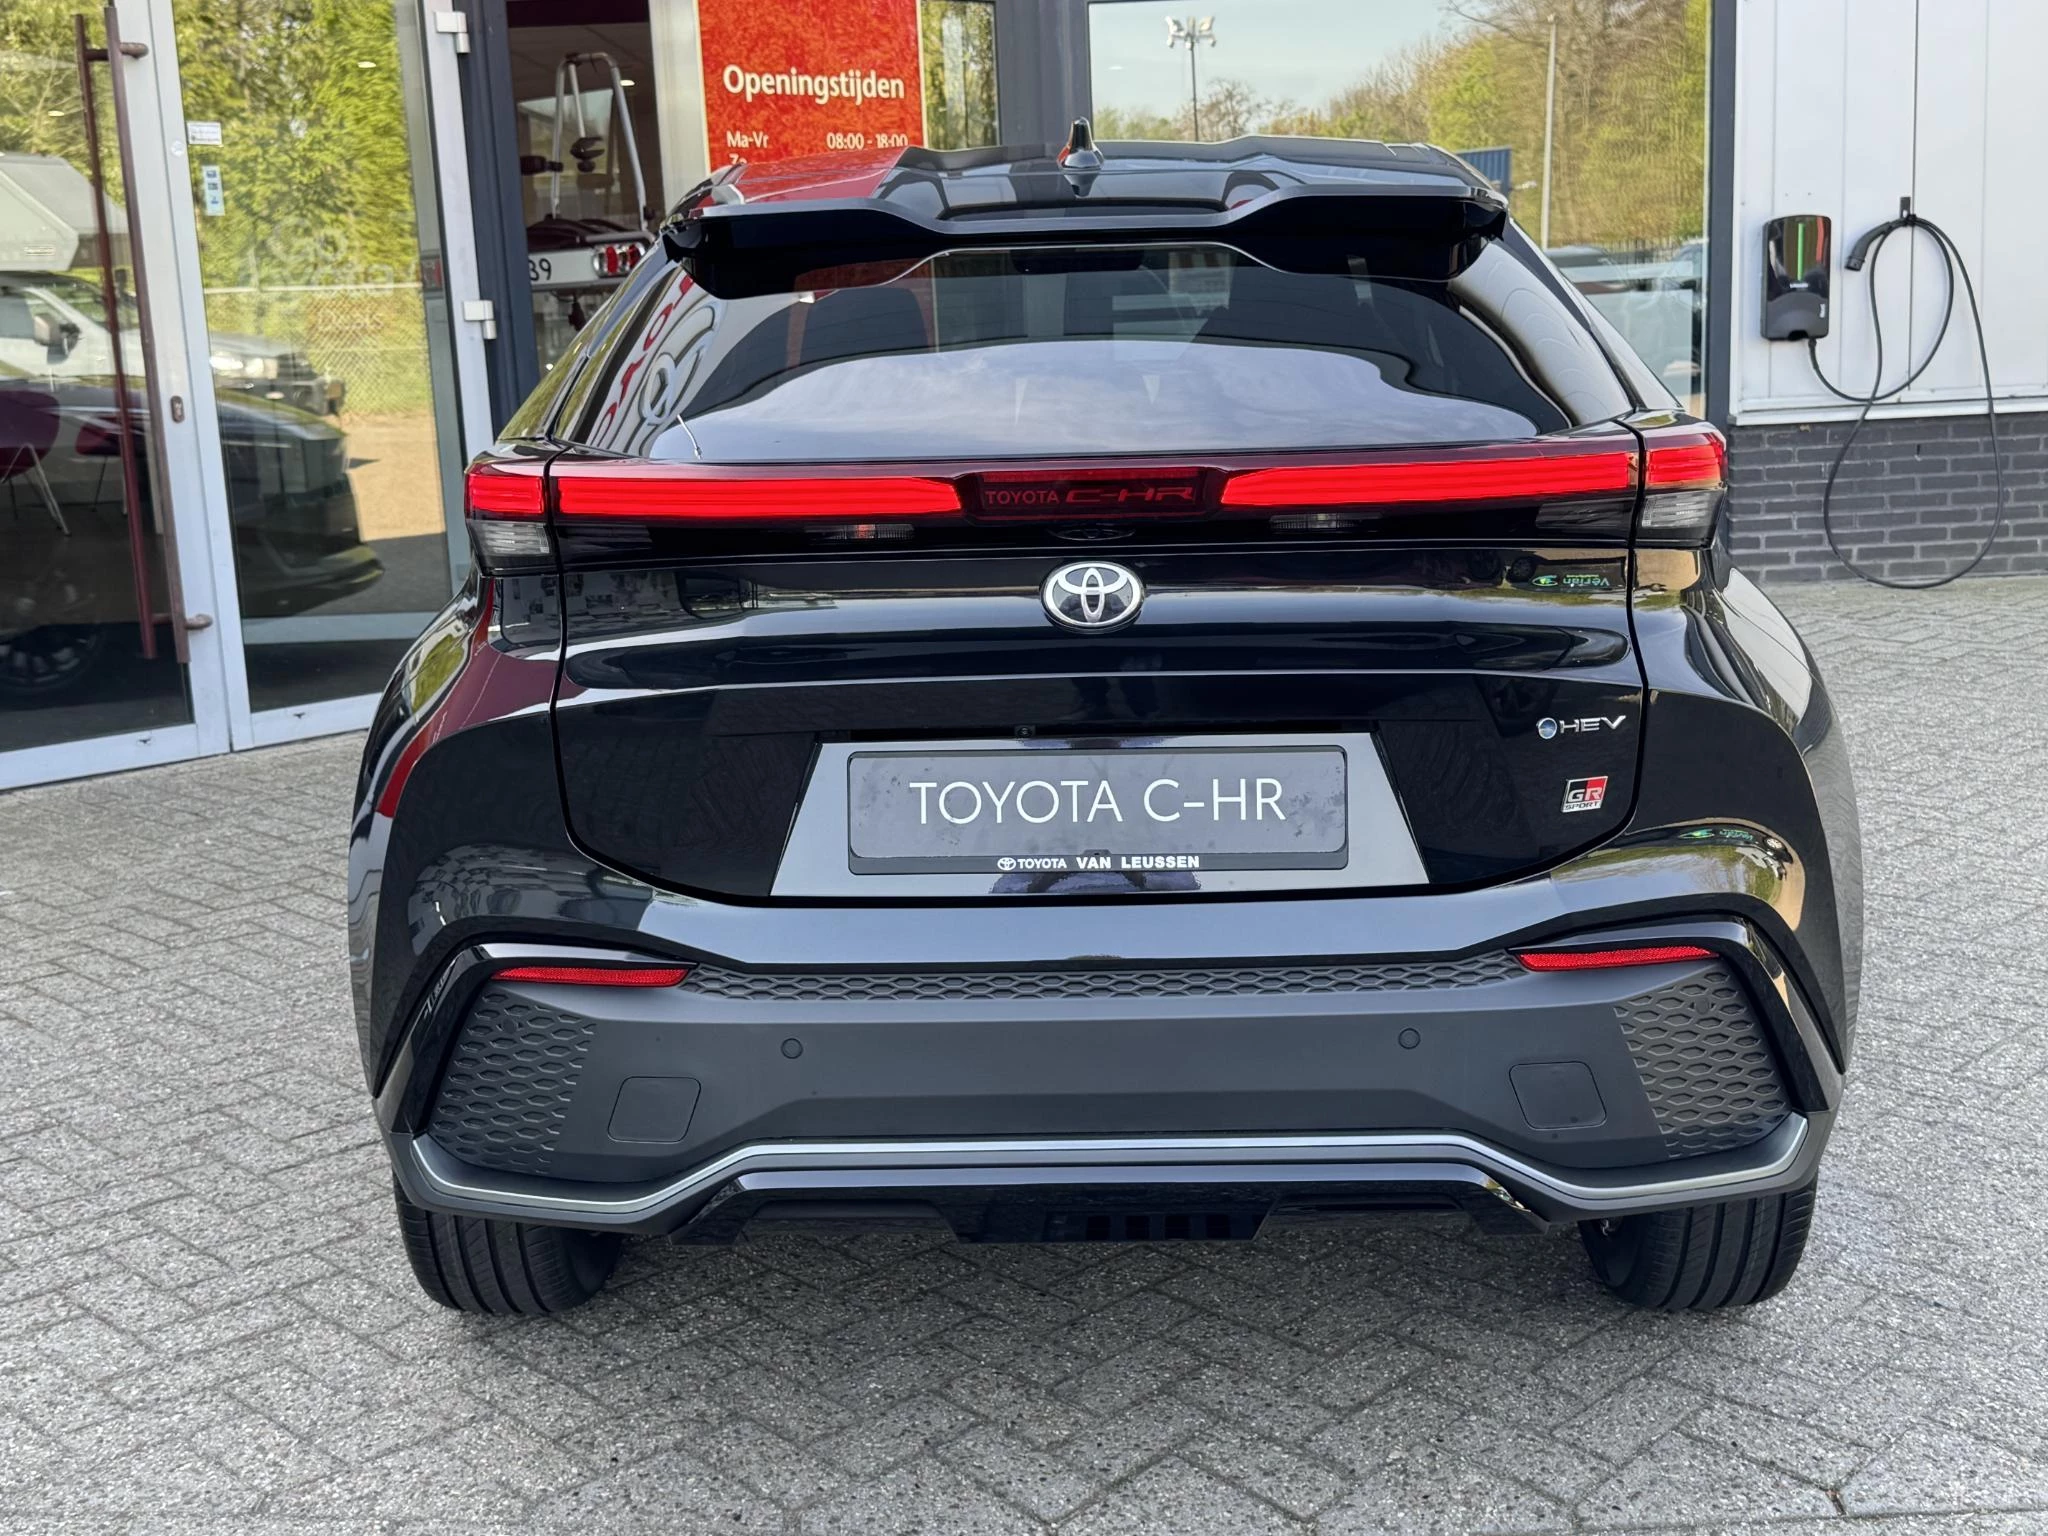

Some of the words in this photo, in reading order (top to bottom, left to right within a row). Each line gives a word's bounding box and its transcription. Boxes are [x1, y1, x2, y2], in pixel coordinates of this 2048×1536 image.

[722, 64, 905, 106] Openingstijden
[726, 130, 769, 149] Ma-Vr
[826, 132, 865, 149] 08:00
[874, 133, 909, 149] 18:00
[984, 489, 1060, 504] TOYOTA
[1066, 486, 1193, 503] C-HR
[1559, 714, 1627, 734] HEV
[909, 780, 1123, 825] TOYOTA
[1143, 778, 1287, 823] C-HR
[1567, 787, 1603, 803] GR
[1565, 801, 1599, 810] SPORT
[1017, 857, 1067, 869] TOYOTA
[1075, 856, 1112, 869] VAN
[1120, 855, 1200, 869] LEUSSEN
